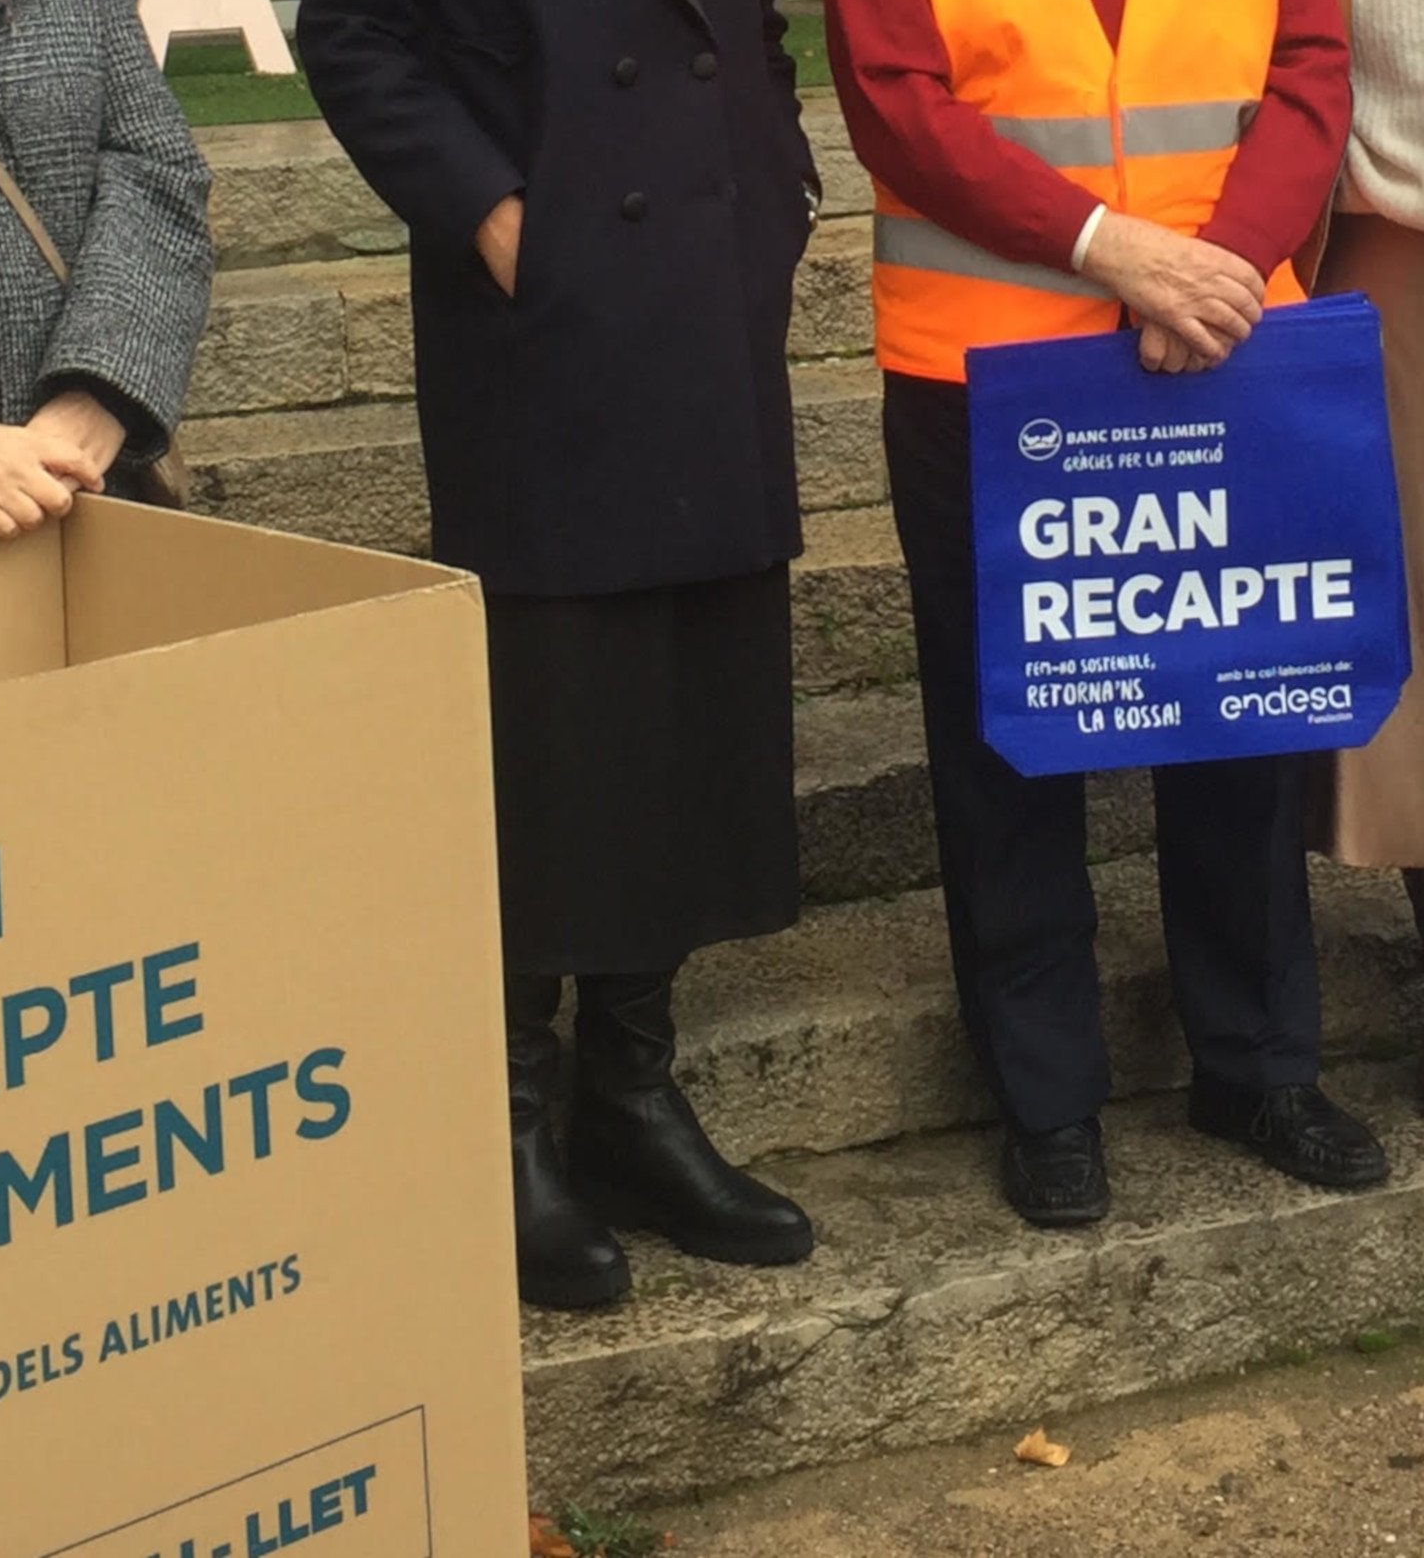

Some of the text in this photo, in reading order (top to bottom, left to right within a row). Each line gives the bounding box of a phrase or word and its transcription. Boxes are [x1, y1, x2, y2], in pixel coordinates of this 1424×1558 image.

[1066, 421, 1226, 444] BANC DELS ALIMENTS
[1062, 442, 1224, 473] GRÀCIES PER LA DONACIÓ
[1018, 488, 1228, 560] GRAN
[1021, 559, 1355, 643] RECAPTE
[1025, 653, 1156, 678] FEM-HO SOSTENIBLE,
[1216, 668, 1243, 683] amb
[1244, 668, 1256, 680] la
[1334, 660, 1354, 673] de:
[1026, 677, 1145, 709] RETORNA'NS
[1220, 683, 1352, 720] endesa
[1077, 700, 1182, 734] LA BOSSA!
[98, 1253, 303, 1363] ALIMENTS
[245, 1464, 376, 1558] LLET
